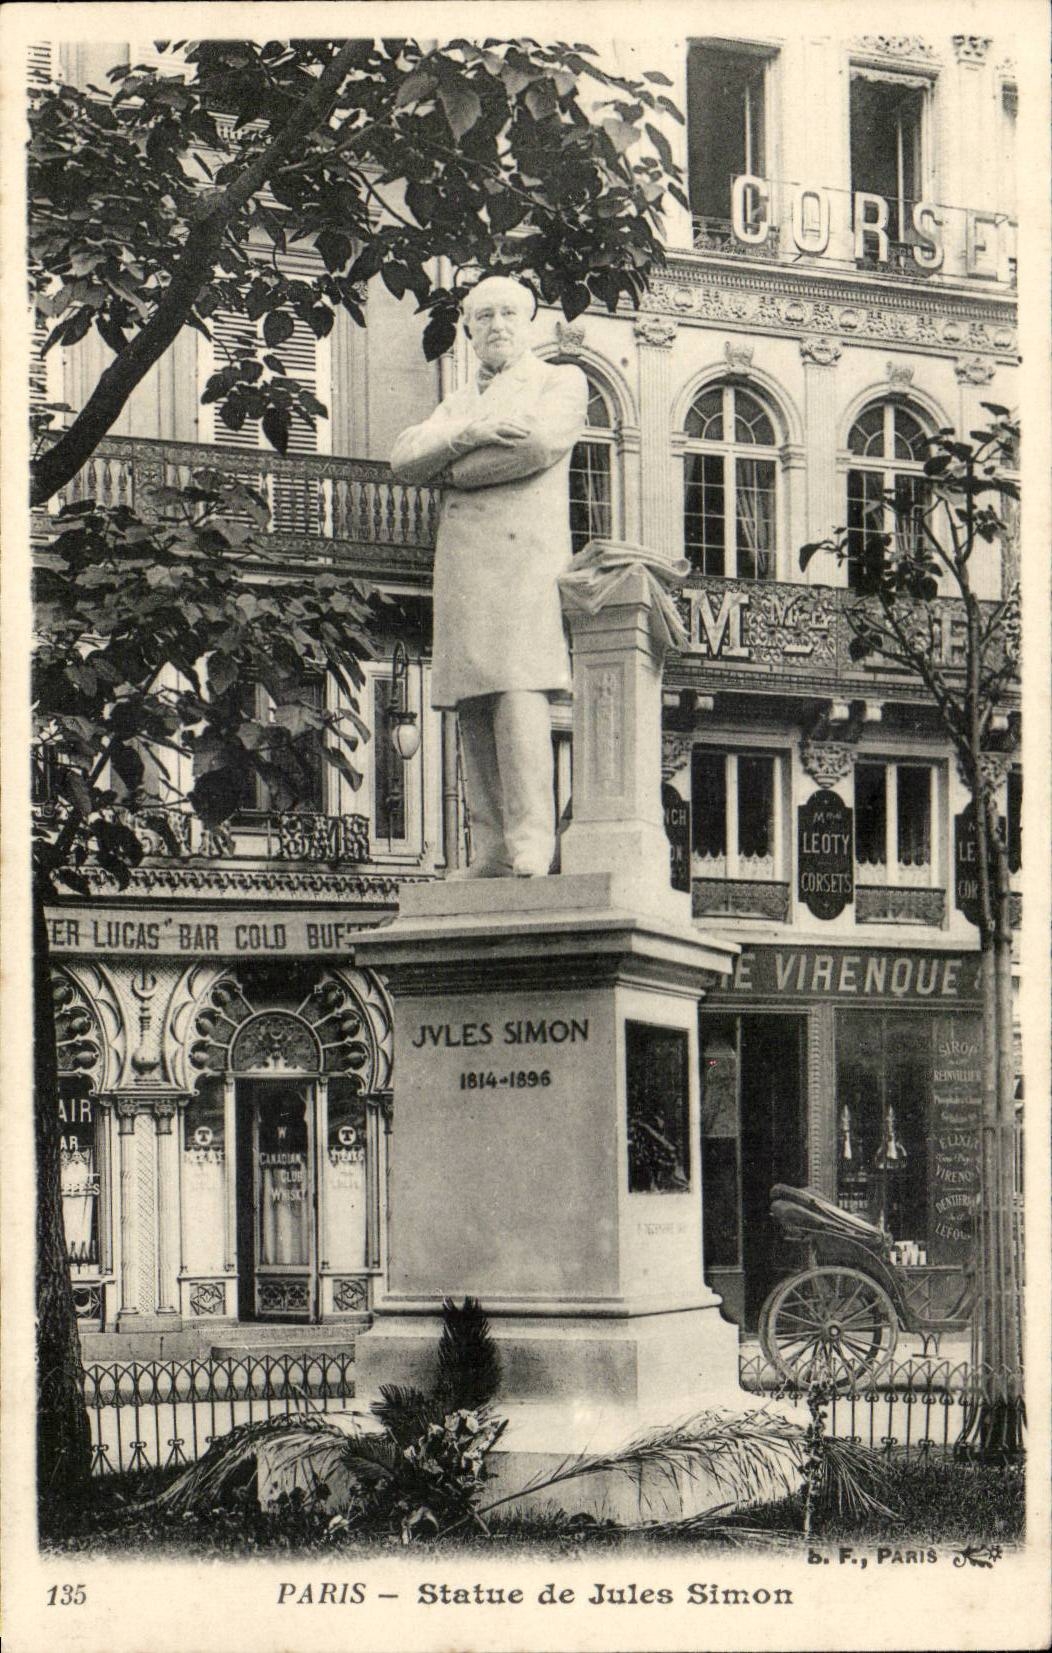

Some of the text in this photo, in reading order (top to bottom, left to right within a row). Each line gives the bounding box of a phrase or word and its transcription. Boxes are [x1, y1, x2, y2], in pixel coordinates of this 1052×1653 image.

[802, 831, 850, 854] LEOTY
[801, 871, 852, 893] CORSETS
[178, 923, 219, 951] BAR
[234, 923, 287, 951] COLD
[306, 921, 380, 950] BUF
[774, 952, 963, 996] VIRENQUE
[503, 1018, 590, 1045] SIMON
